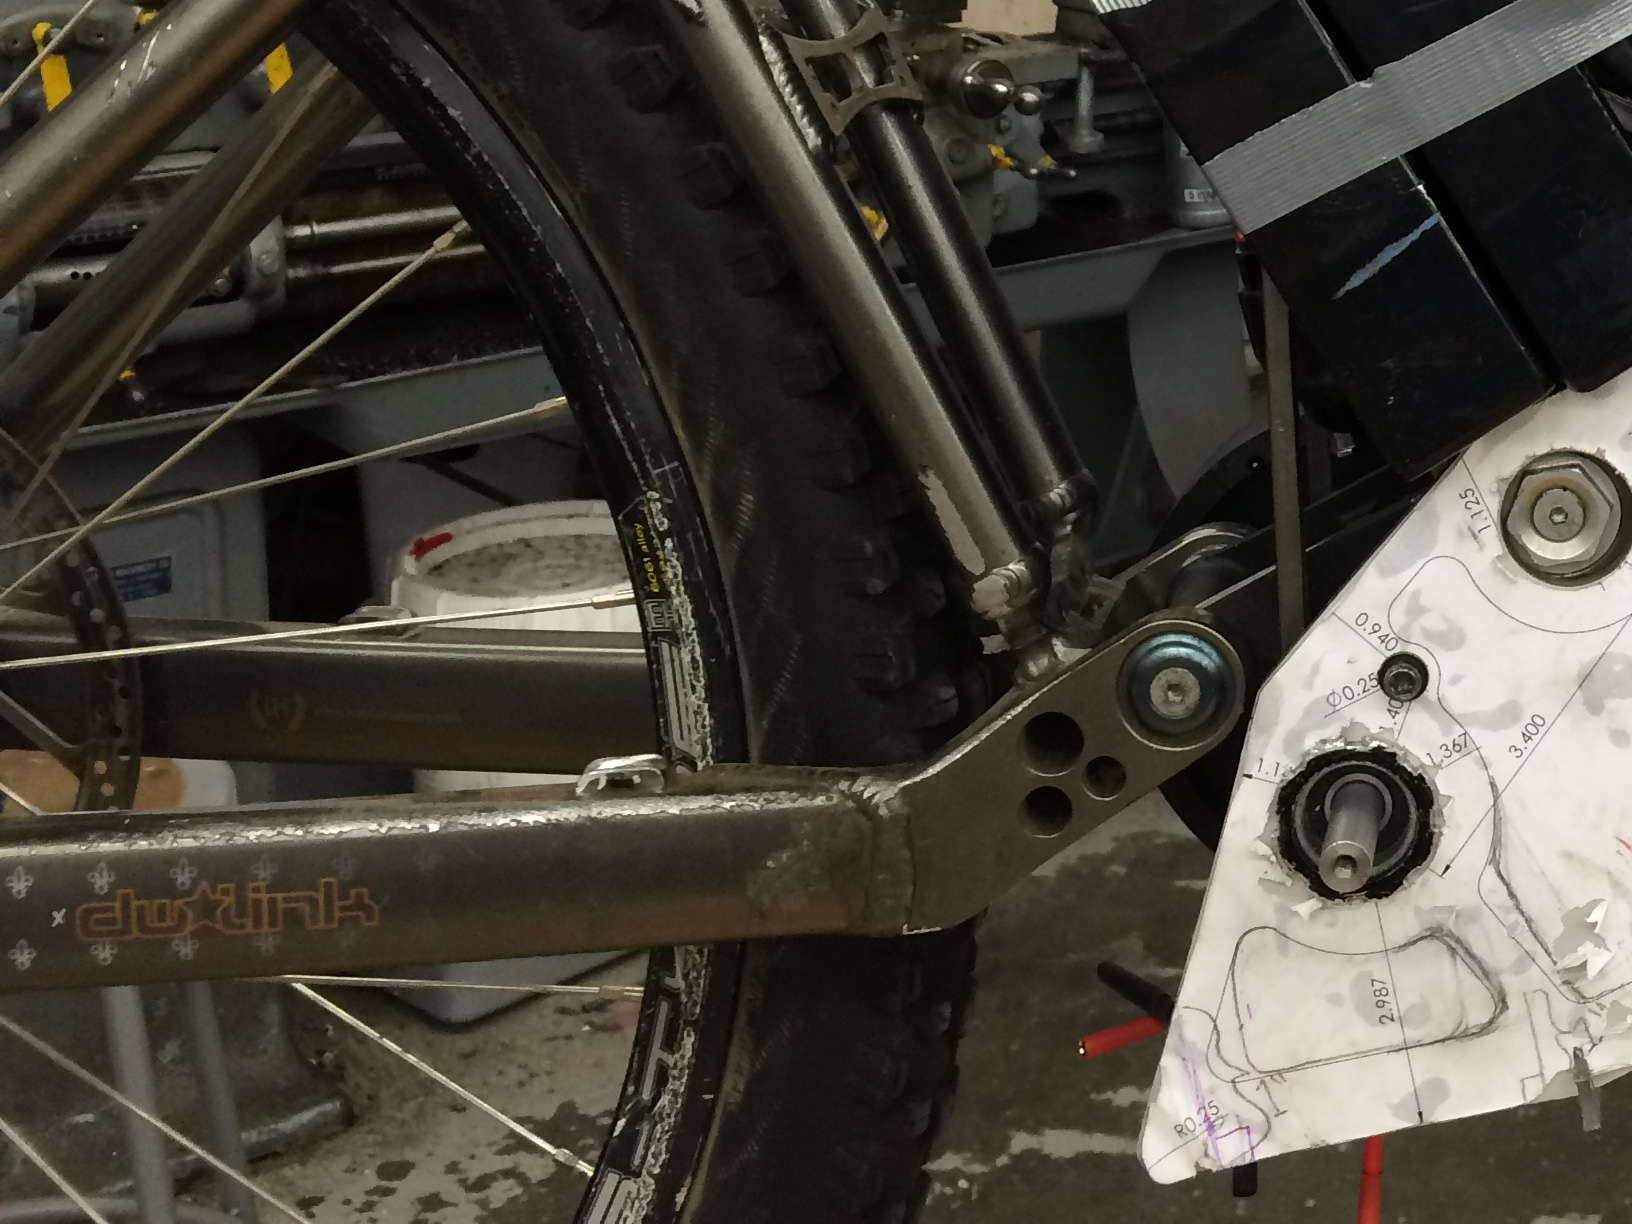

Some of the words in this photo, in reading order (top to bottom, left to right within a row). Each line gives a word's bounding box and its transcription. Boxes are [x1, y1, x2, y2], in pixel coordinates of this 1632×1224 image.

[1459, 487, 1492, 535] 1.125
[633, 522, 650, 554] alloy
[1354, 611, 1400, 652] 0.940
[1507, 712, 1547, 760] 3.400
[1370, 978, 1396, 1026] 2.987
[1173, 1099, 1221, 1139] R0.25
